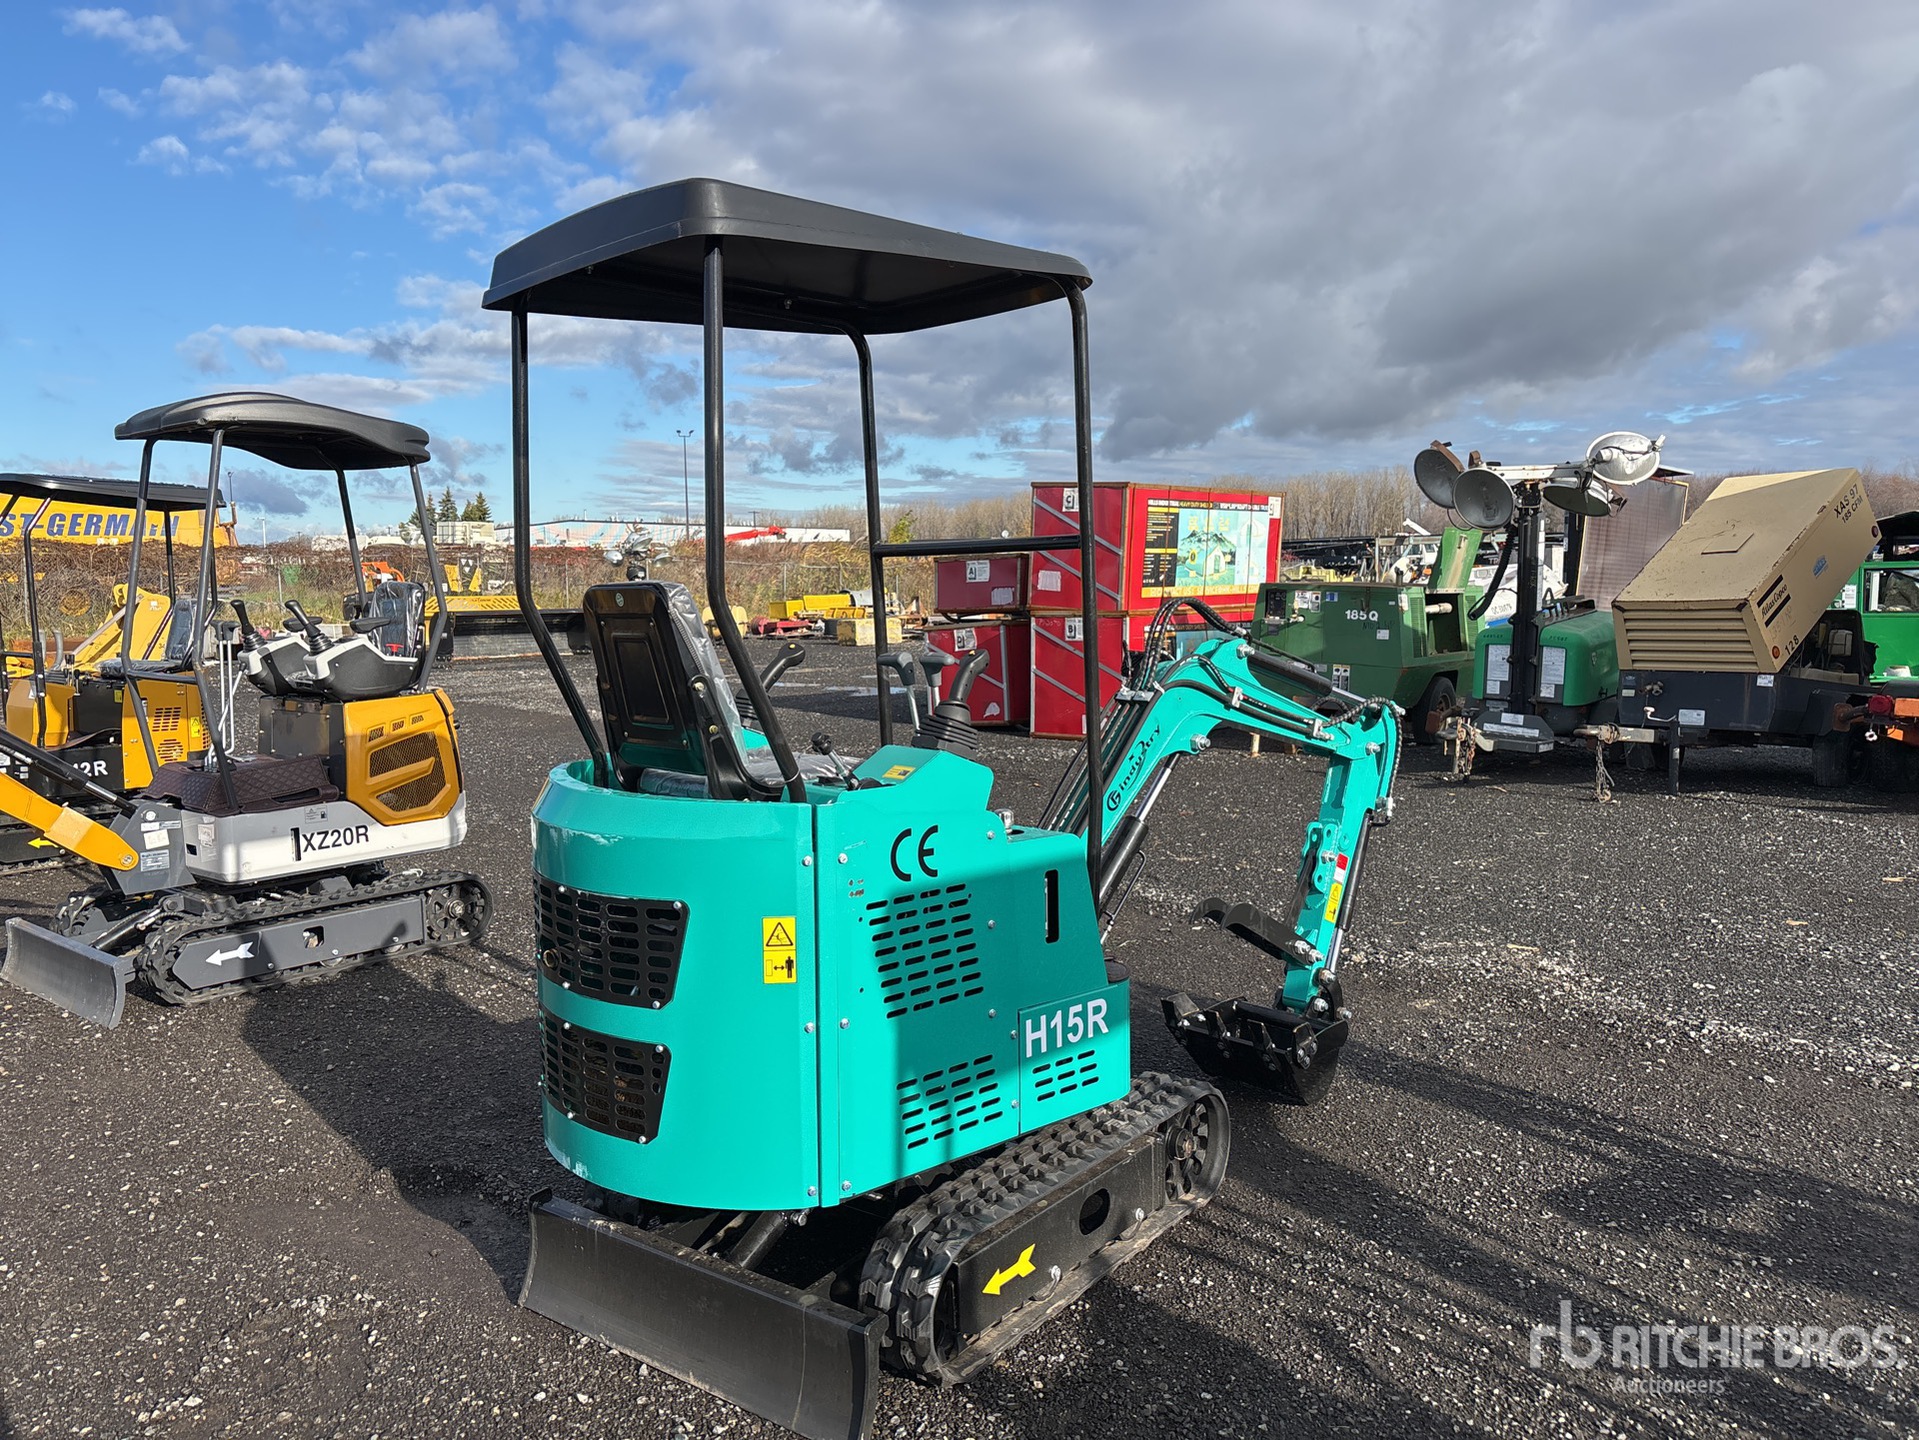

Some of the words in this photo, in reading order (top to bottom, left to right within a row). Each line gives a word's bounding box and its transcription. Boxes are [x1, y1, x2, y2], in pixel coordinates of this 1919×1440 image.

[1833, 495, 1850, 518] XAS
[1849, 483, 1859, 499] 97
[1842, 509, 1852, 523] 185
[1784, 634, 1800, 655] 128
[302, 824, 369, 852] XZ20R
[890, 824, 939, 882] CE
[1025, 998, 1109, 1058] H15R
